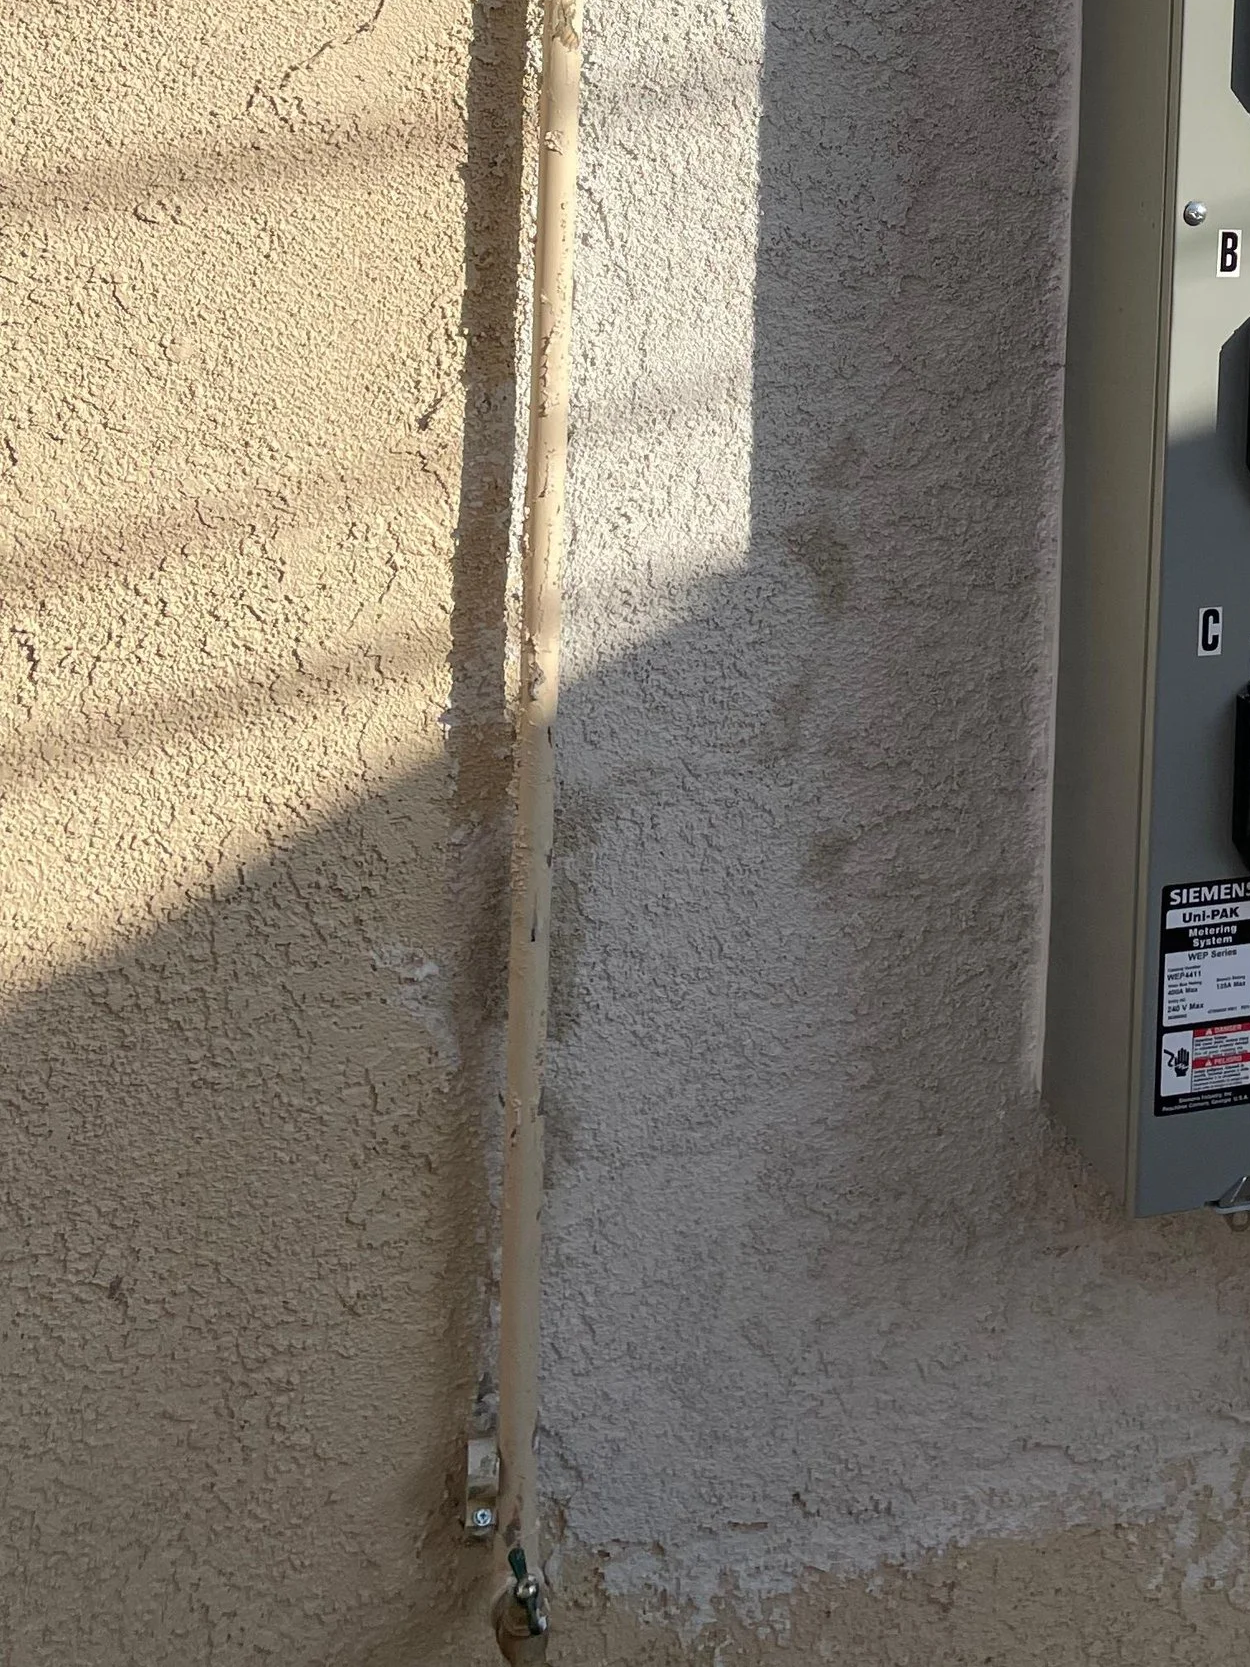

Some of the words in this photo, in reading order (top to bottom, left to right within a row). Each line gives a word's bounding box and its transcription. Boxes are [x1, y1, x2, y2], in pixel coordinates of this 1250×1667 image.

[1219, 231, 1239, 273] B
[1202, 608, 1220, 652] C
[1182, 906, 1240, 923] Uni-PAK
[1188, 925, 1238, 937] Metering
[1192, 936, 1233, 948] System
[1188, 951, 1209, 961] WEP
[1210, 949, 1238, 958] Series
